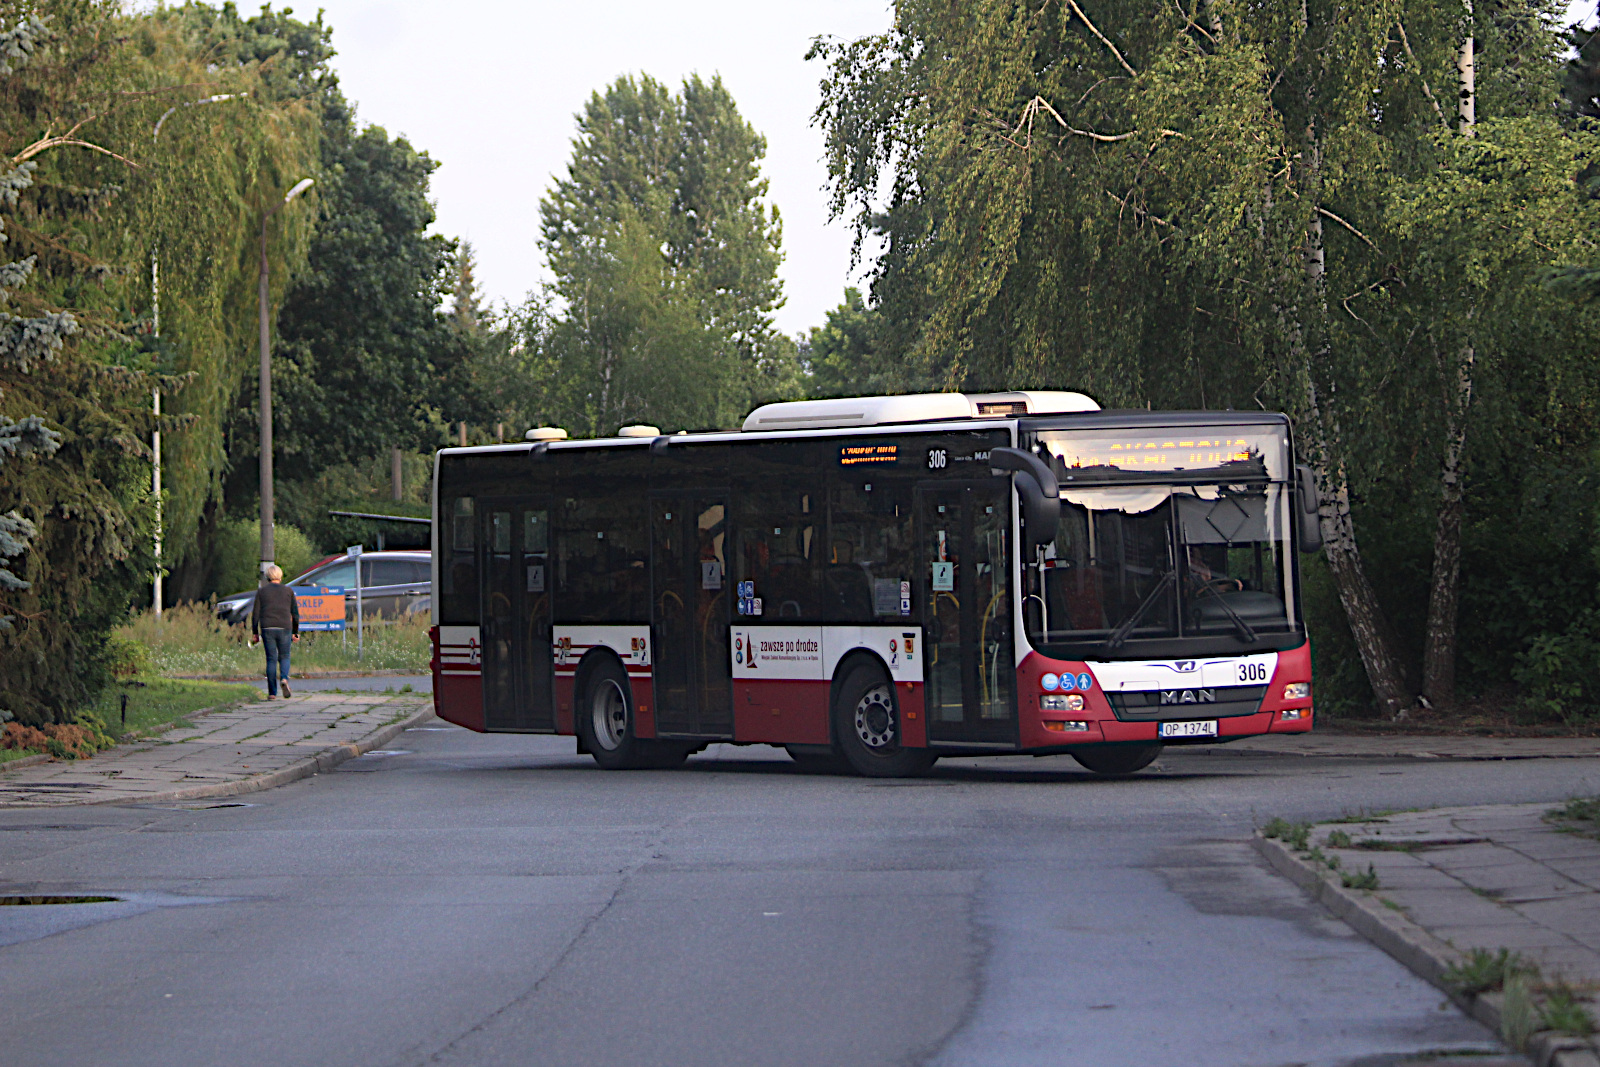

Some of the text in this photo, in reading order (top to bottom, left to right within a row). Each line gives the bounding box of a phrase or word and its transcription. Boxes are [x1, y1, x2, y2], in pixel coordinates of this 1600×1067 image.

[928, 449, 947, 469] 306
[296, 598, 324, 608] SKLEP
[760, 641, 784, 652] zawsze
[785, 641, 794, 655] po
[795, 638, 818, 652] drodze
[1238, 662, 1266, 682] 306
[1160, 688, 1216, 704] MAN
[1165, 722, 1214, 735] OP 1374L
